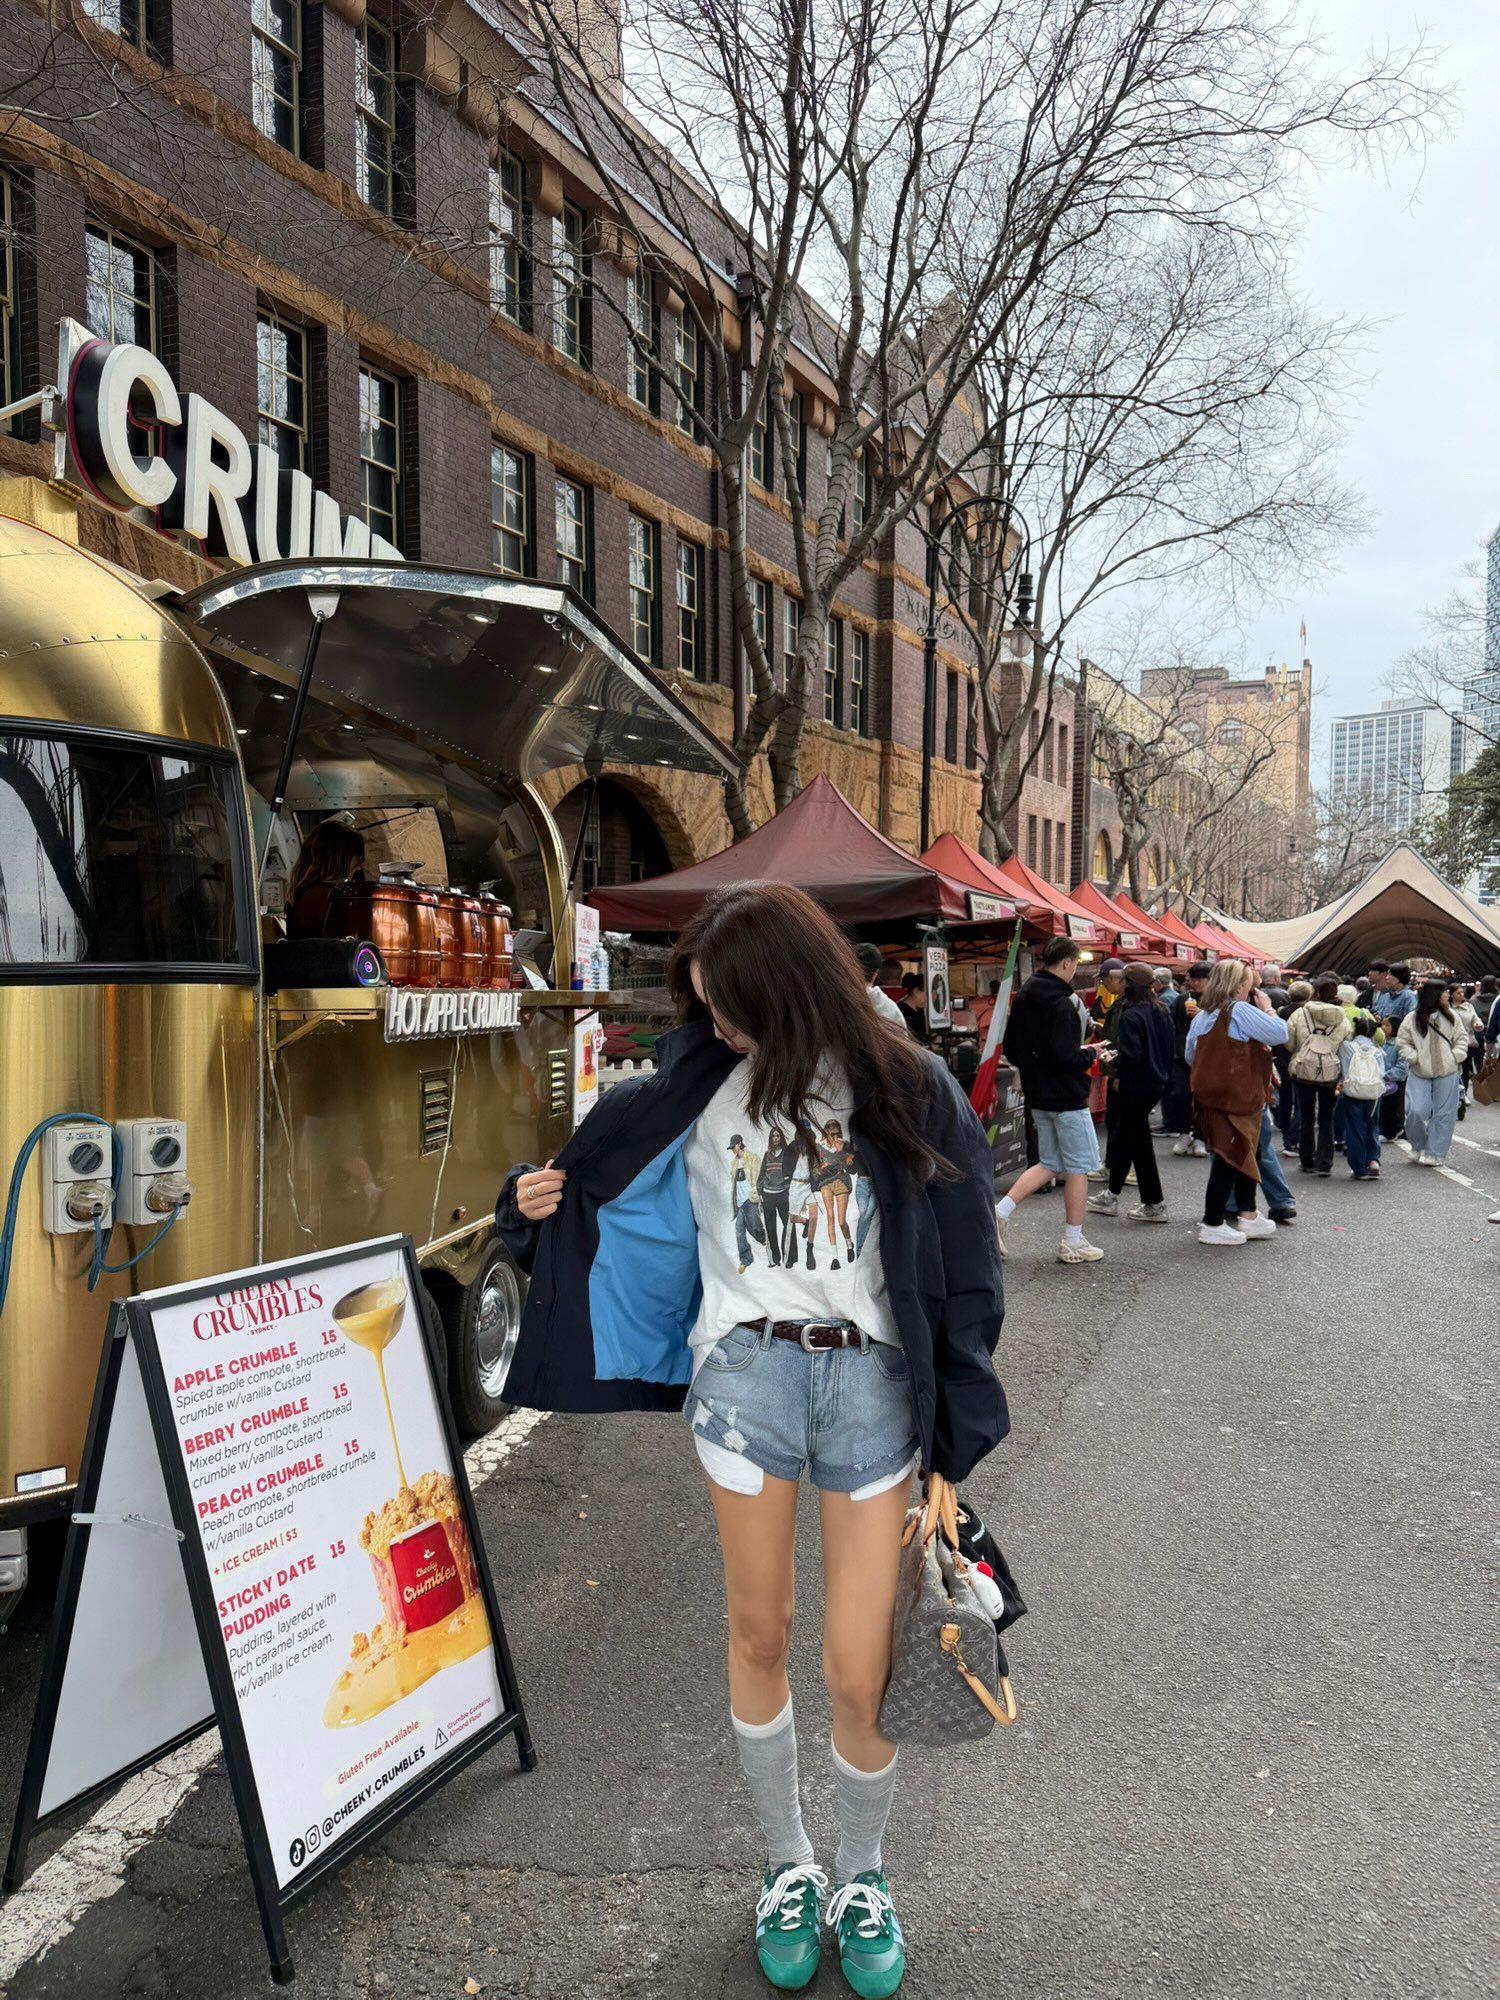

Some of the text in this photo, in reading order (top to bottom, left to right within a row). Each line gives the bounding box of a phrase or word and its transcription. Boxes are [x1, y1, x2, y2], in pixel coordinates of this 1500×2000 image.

[929, 951, 946, 961] VERA
[929, 962, 946, 972] PIZZA
[389, 988, 522, 1035] HOT APPLE CRUMBLE
[193, 1283, 324, 1341] CRUMBLES
[174, 1329, 338, 1393] APPLE CRUMBLE 15
[176, 1343, 346, 1409] Spiced apple compote, shortbread
[179, 1371, 312, 1426] crumble w/vanilla Custard
[184, 1383, 349, 1455] BERRY CRUMBLE 15
[189, 1400, 352, 1473] Mixed berry compote, shortbread
[192, 1427, 323, 1489] crumble w/vanilla Custard
[198, 1439, 360, 1518] PEACH CRUMBLE 15
[202, 1451, 376, 1534] Peach compote, shortbread crumble
[206, 1501, 294, 1551] w/vanilla Custard
[222, 1555, 241, 1573] ICE
[242, 1537, 278, 1563] CREAM
[285, 1527, 298, 1542] $3
[218, 1540, 346, 1618] STICKY DATE 15
[403, 1565, 457, 1604] Crumbles
[223, 1593, 291, 1642] PUDDING
[229, 1592, 337, 1663] Pudding, layered with
[233, 1617, 328, 1682] rich caramel sauce.
[237, 1632, 335, 1700] w/vanilla ice cream.
[447, 1697, 491, 1729] Crumble Contains
[448, 1719, 469, 1738] Almond
[337, 1720, 420, 1785] Gluten Free Available
[322, 1745, 426, 1837] @CHEEKY.CRUMBLES
